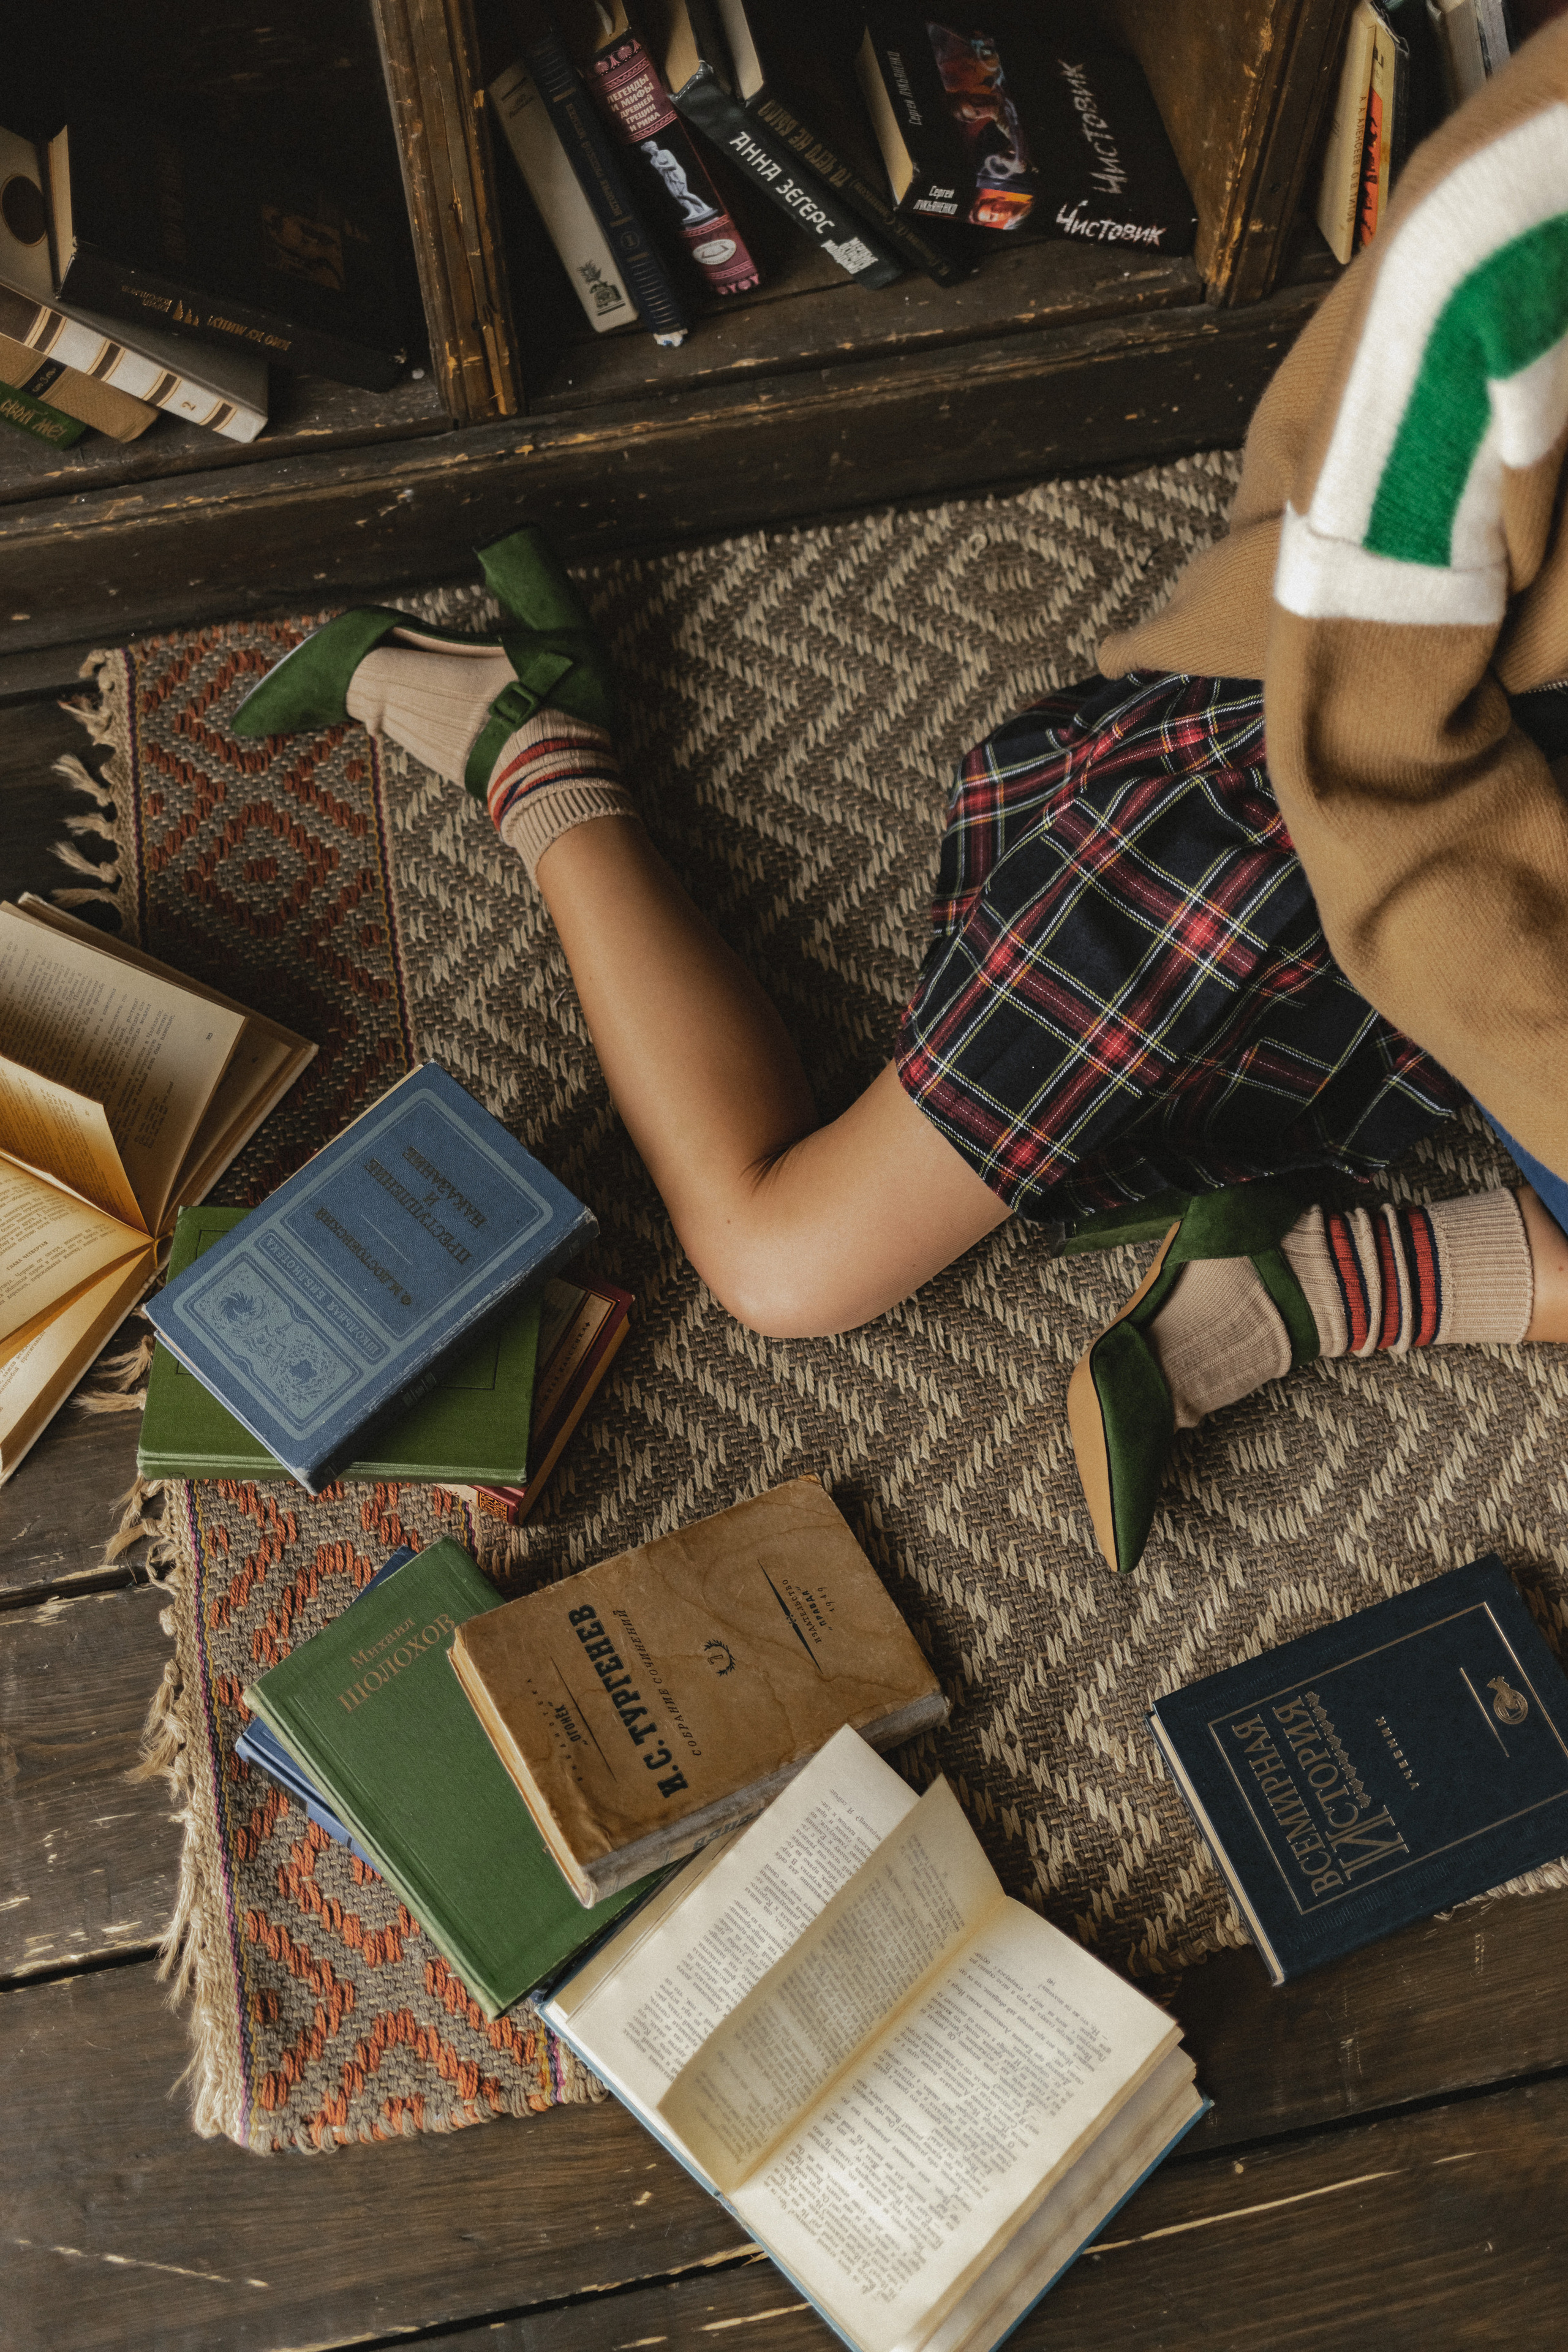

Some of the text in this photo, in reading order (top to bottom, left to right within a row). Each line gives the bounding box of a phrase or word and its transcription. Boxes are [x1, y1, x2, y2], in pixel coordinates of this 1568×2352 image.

[605, 73, 650, 105] ЛЕГЕНДЫ
[610, 81, 655, 112] И МИФЫ
[618, 93, 654, 119] ДРЕВНЕЙ
[625, 103, 656, 125] ГРЕЦИИ
[628, 110, 660, 132] И РИМА
[786, 127, 815, 152] НЕ
[804, 143, 836, 175] ЧЕГО
[729, 130, 835, 235] АННА ЗЕГЕРС
[401, 1145, 488, 1230] НАКАЗАНИЕ
[422, 1190, 440, 1208] И
[362, 1156, 473, 1265] ПРЕСТУПЛЕНИЕ
[5, 1238, 48, 1271] ГЛАВА ЧЕТВЕРТАЯ
[263, 1236, 381, 1355] ШКОЛЬНАЯ БИБЛИОТЕКА
[781, 1578, 822, 1644] ИЗДАТЕЛЬСТВО
[816, 1585, 835, 1612] 1949
[349, 1616, 416, 1670] Михаил
[706, 1653, 723, 1665] 7
[336, 1610, 458, 1714] ШОЛОХОВ
[612, 1607, 703, 1758] СОБРАНИЕ СОЧИНЕНИЙ
[1374, 1715, 1419, 1790] УЧЕБНИК
[827, 1788, 847, 1807] сейчас
[1231, 1713, 1344, 1897] ВСЕМИРНАЯ
[802, 1856, 820, 1874] прямо
[833, 1844, 853, 1863] голову
[725, 1936, 762, 1972] даже улыбка
